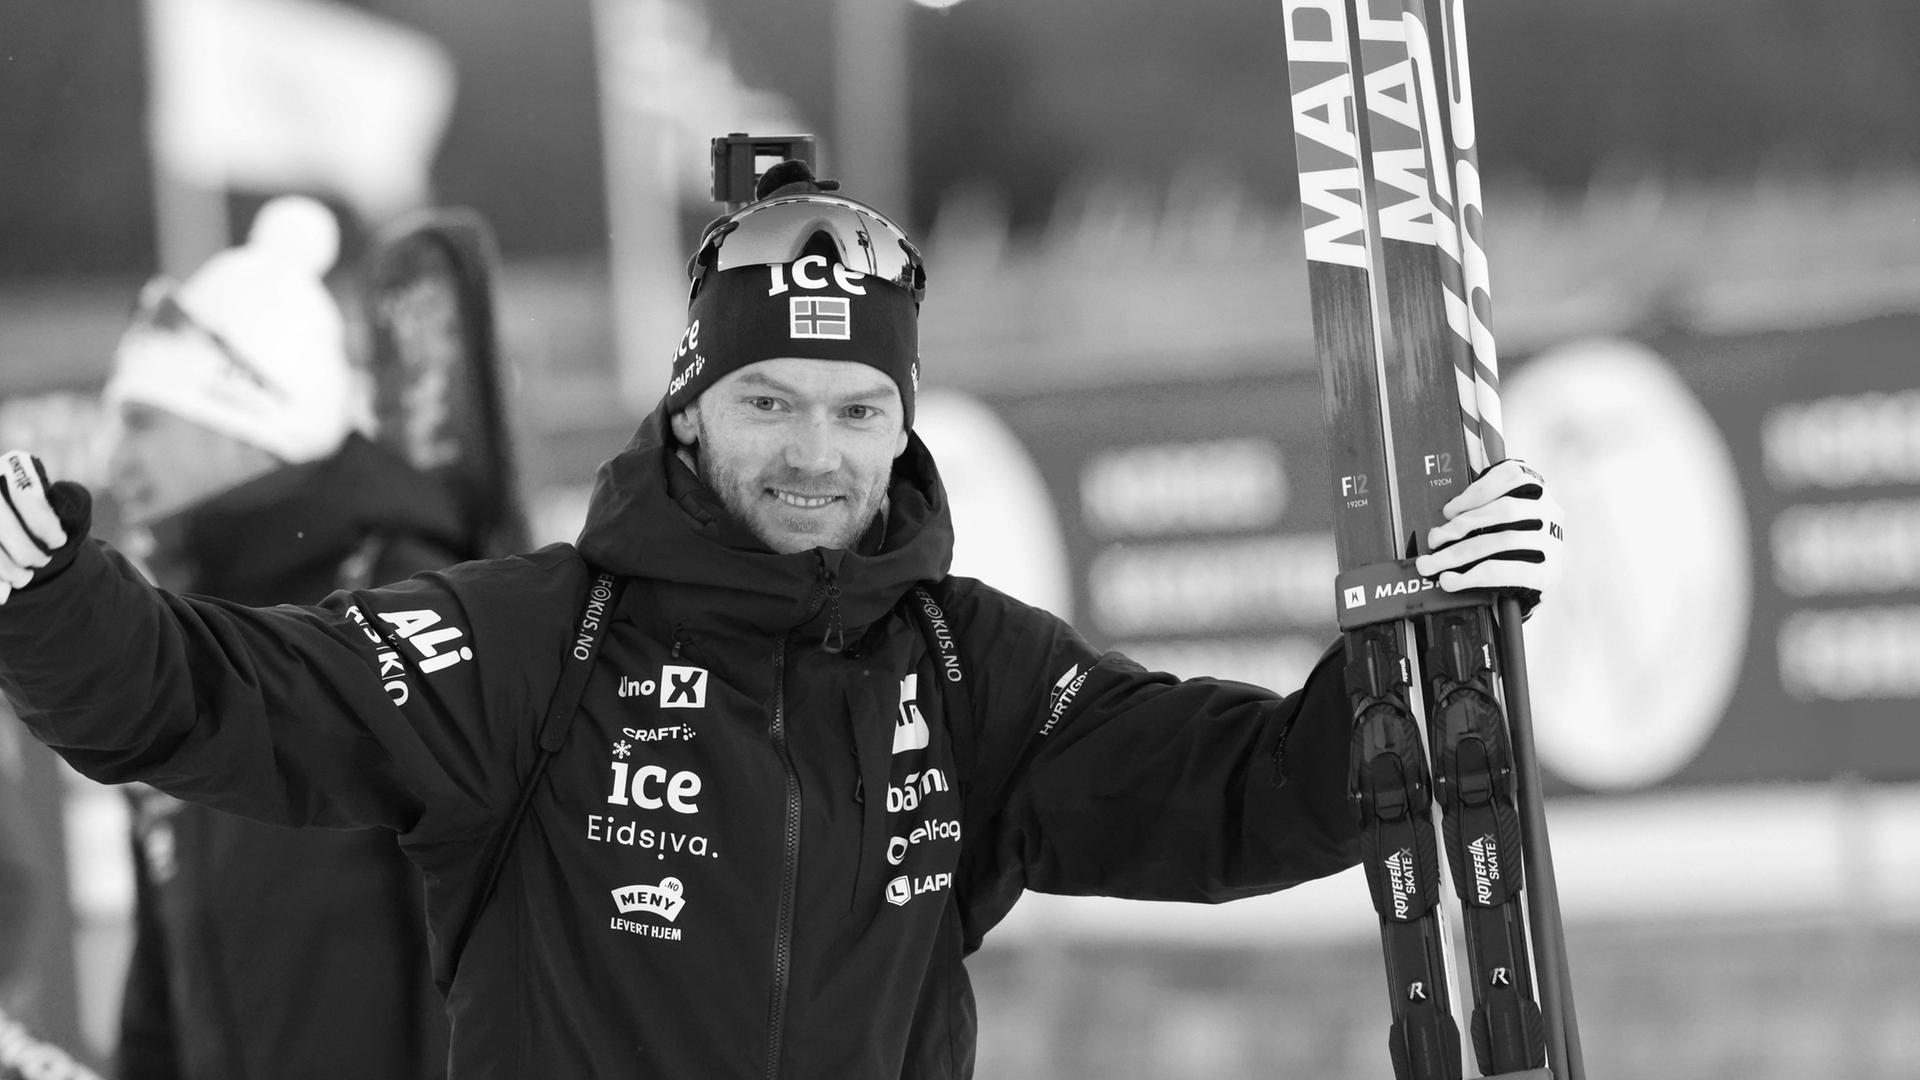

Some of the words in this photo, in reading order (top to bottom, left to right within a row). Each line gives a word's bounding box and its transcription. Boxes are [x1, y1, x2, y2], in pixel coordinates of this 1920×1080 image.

[670, 362, 695, 396] CRAFT
[1429, 478, 1452, 488] 192CM
[1345, 499, 1368, 509] 192CM
[1375, 578, 1440, 599] MADS
[618, 676, 656, 698] Uno
[667, 671, 703, 703] X
[622, 726, 681, 741] CRAFT
[607, 739, 702, 814] ice
[620, 891, 676, 911] MENY
[610, 917, 649, 937] LEVERT
[651, 926, 682, 942] HJEM
[1491, 967, 1509, 985] R
[1409, 981, 1426, 1000] R
